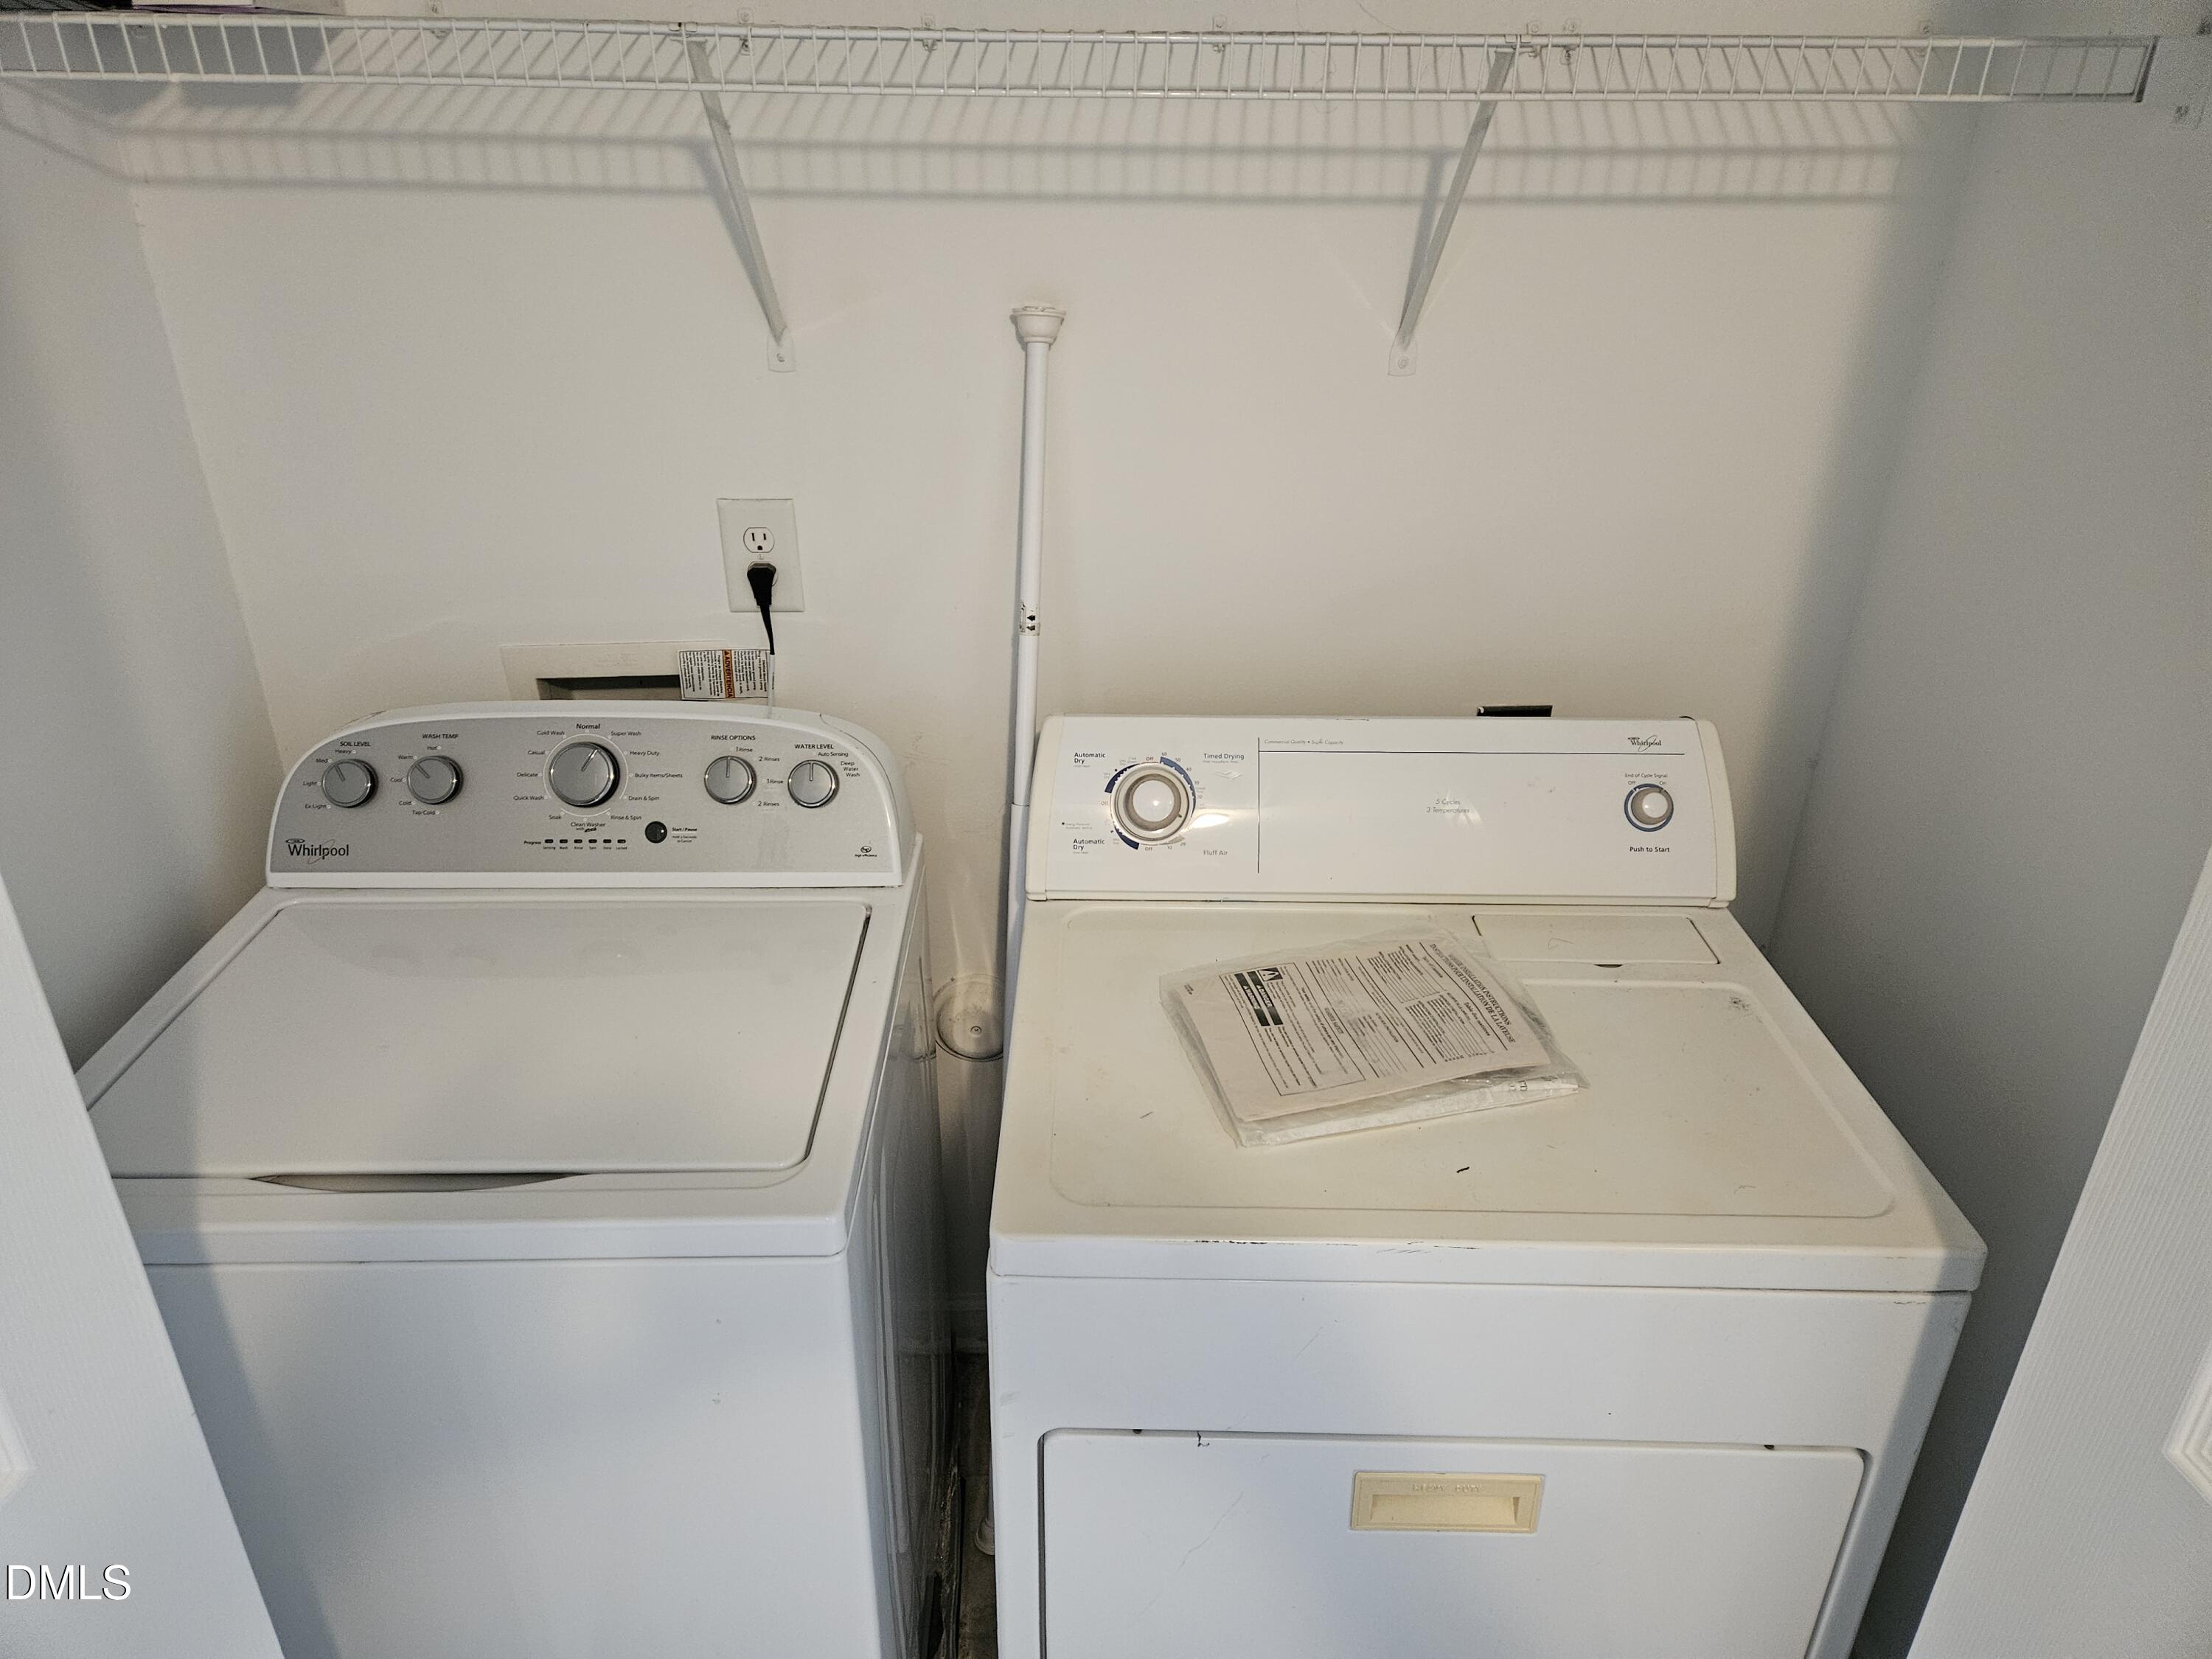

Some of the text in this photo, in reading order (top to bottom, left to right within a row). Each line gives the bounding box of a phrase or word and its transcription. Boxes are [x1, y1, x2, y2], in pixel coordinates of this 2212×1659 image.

[288, 844, 349, 860] Whirlpool
[1258, 988, 1273, 1007] DANGER
[1483, 990, 1512, 1026] INSTRUCTIONS
[1485, 1006, 1495, 1014] DE
[1490, 1014, 1501, 1023] LA
[1495, 1022, 1517, 1043] LAVEUSE
